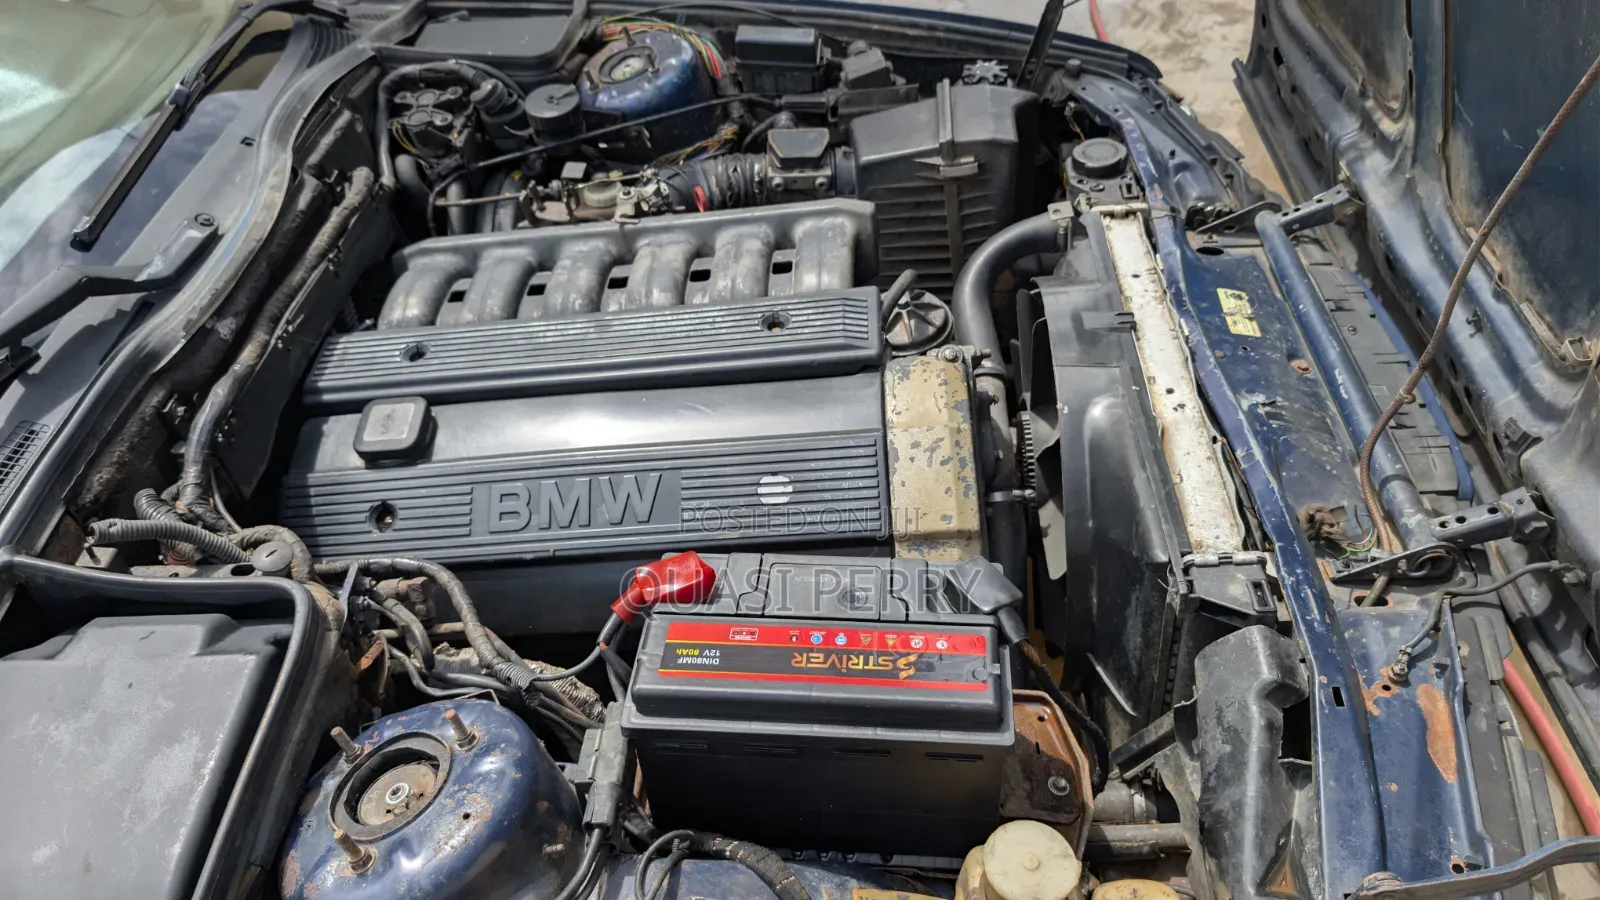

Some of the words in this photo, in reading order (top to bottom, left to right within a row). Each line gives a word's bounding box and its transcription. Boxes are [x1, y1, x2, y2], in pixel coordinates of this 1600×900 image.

[489, 473, 662, 534] BMW
[676, 648, 700, 656] 80Ah
[703, 649, 721, 657] 12V
[676, 656, 720, 665] DIN80MF
